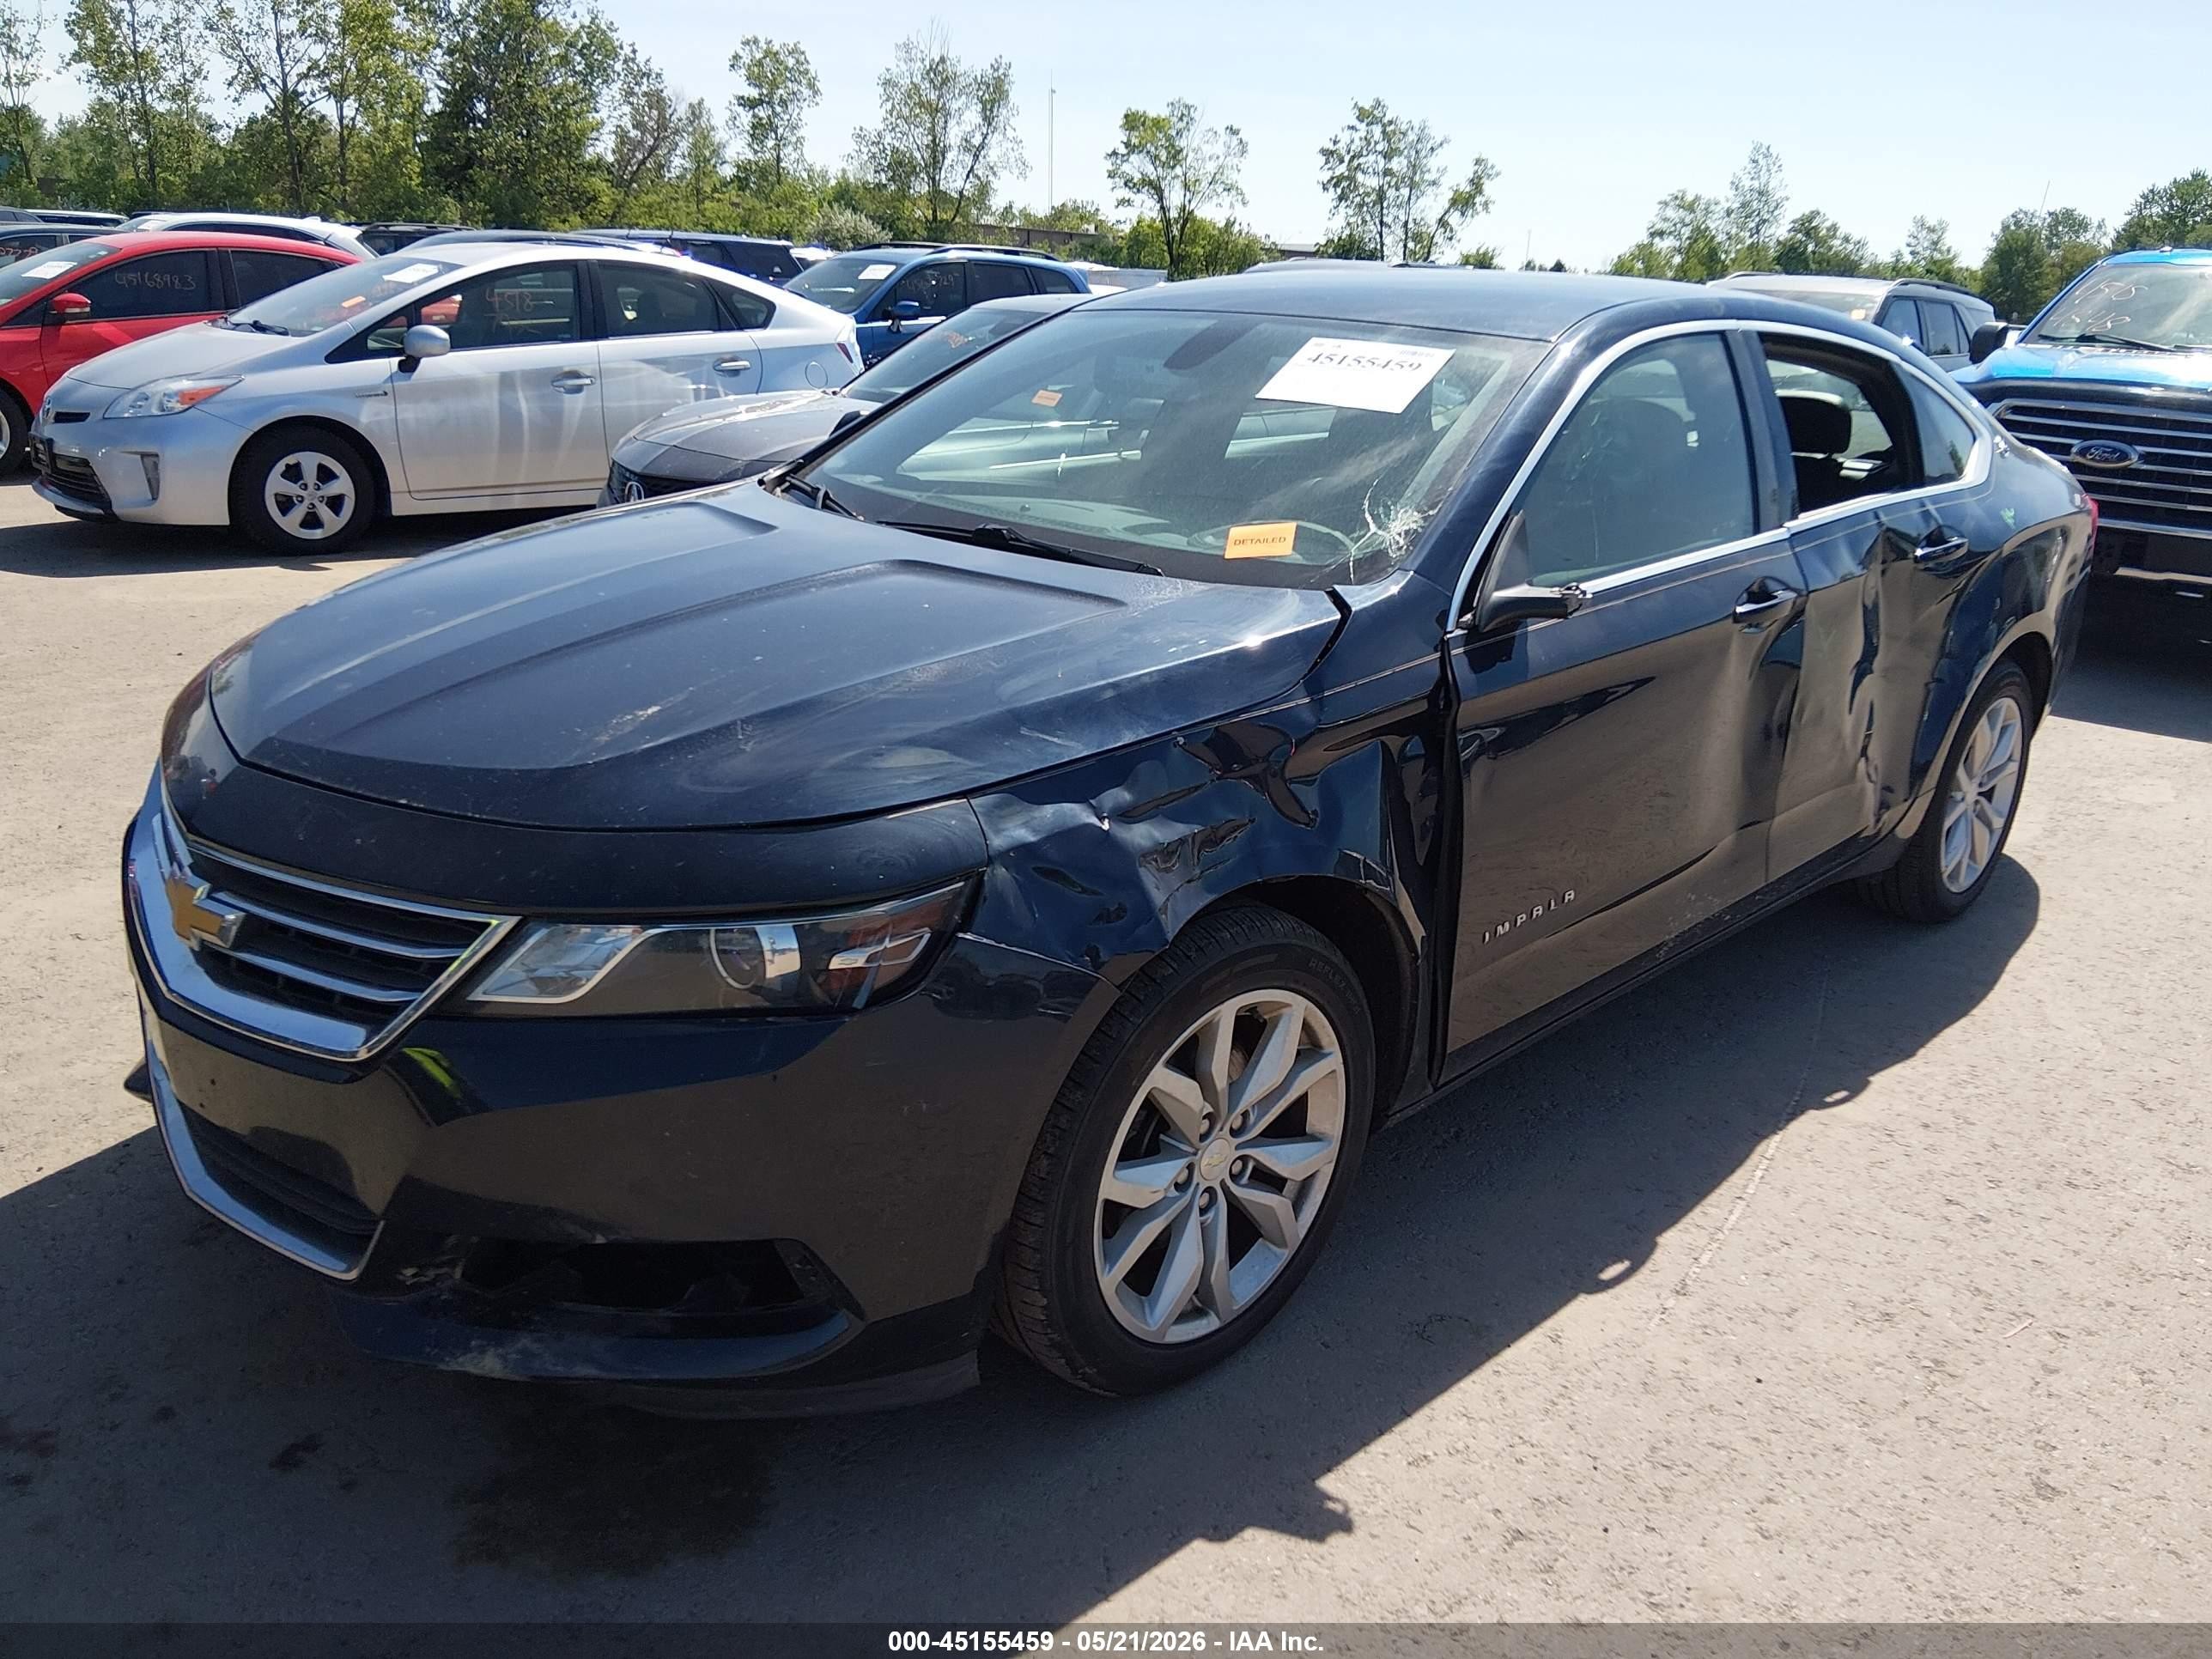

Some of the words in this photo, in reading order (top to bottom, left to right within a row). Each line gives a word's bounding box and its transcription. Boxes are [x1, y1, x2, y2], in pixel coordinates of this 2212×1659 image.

[1307, 352, 1422, 372] 45155459
[2086, 447, 2122, 462] Ford
[1234, 536, 1286, 546] DETAILED
[1483, 890, 1575, 945] IMPALA
